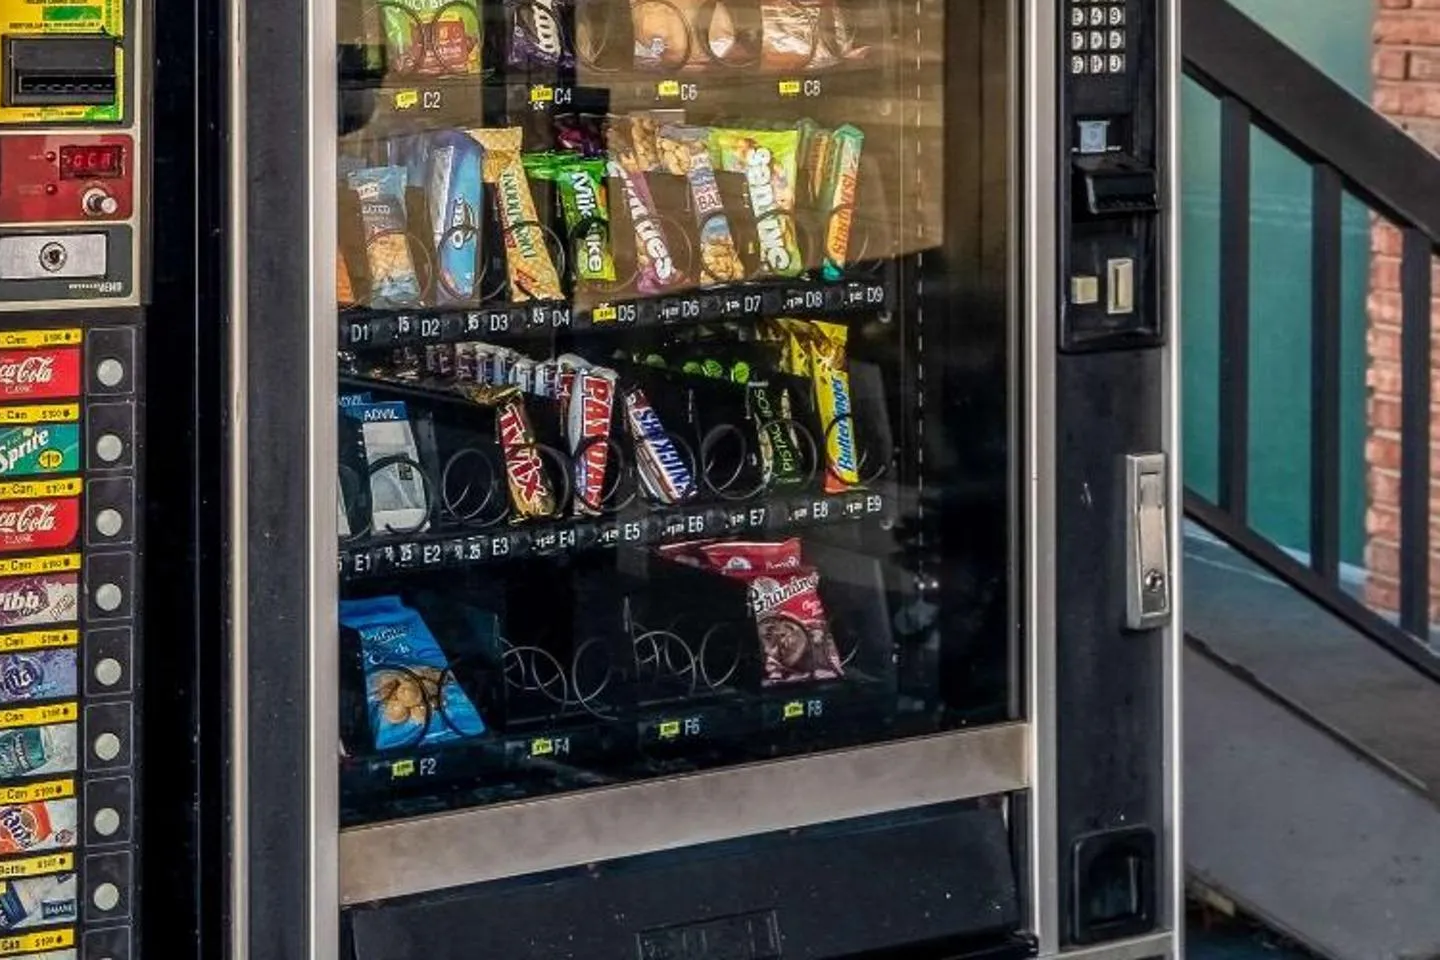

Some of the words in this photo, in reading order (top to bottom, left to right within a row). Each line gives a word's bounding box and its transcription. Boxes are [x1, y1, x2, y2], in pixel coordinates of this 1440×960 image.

[424, 92, 440, 109] C2
[555, 89, 571, 105] C4
[681, 84, 697, 101] C6
[804, 80, 820, 97] C8
[351, 324, 368, 342] D1
[422, 319, 440, 337] D2
[491, 315, 508, 331] D3
[553, 309, 569, 326] D4
[618, 305, 635, 321] D5
[683, 300, 699, 317] D6
[744, 296, 761, 313] D7
[806, 292, 823, 308] D8
[867, 286, 884, 302] D9
[363, 407, 399, 420] ADVIL
[756, 387, 792, 472] PISTACIOS
[831, 373, 854, 471] Butteringer
[498, 402, 547, 502] TWIX
[355, 555, 371, 571] E1
[424, 547, 440, 563] E2
[492, 539, 508, 555] E3
[559, 531, 575, 547] E4
[625, 523, 640, 540] E5
[688, 516, 703, 533] E6
[750, 509, 766, 526] E7
[813, 502, 828, 518] E8
[867, 496, 882, 512] E9
[420, 759, 437, 775] F2
[554, 739, 570, 755] F4
